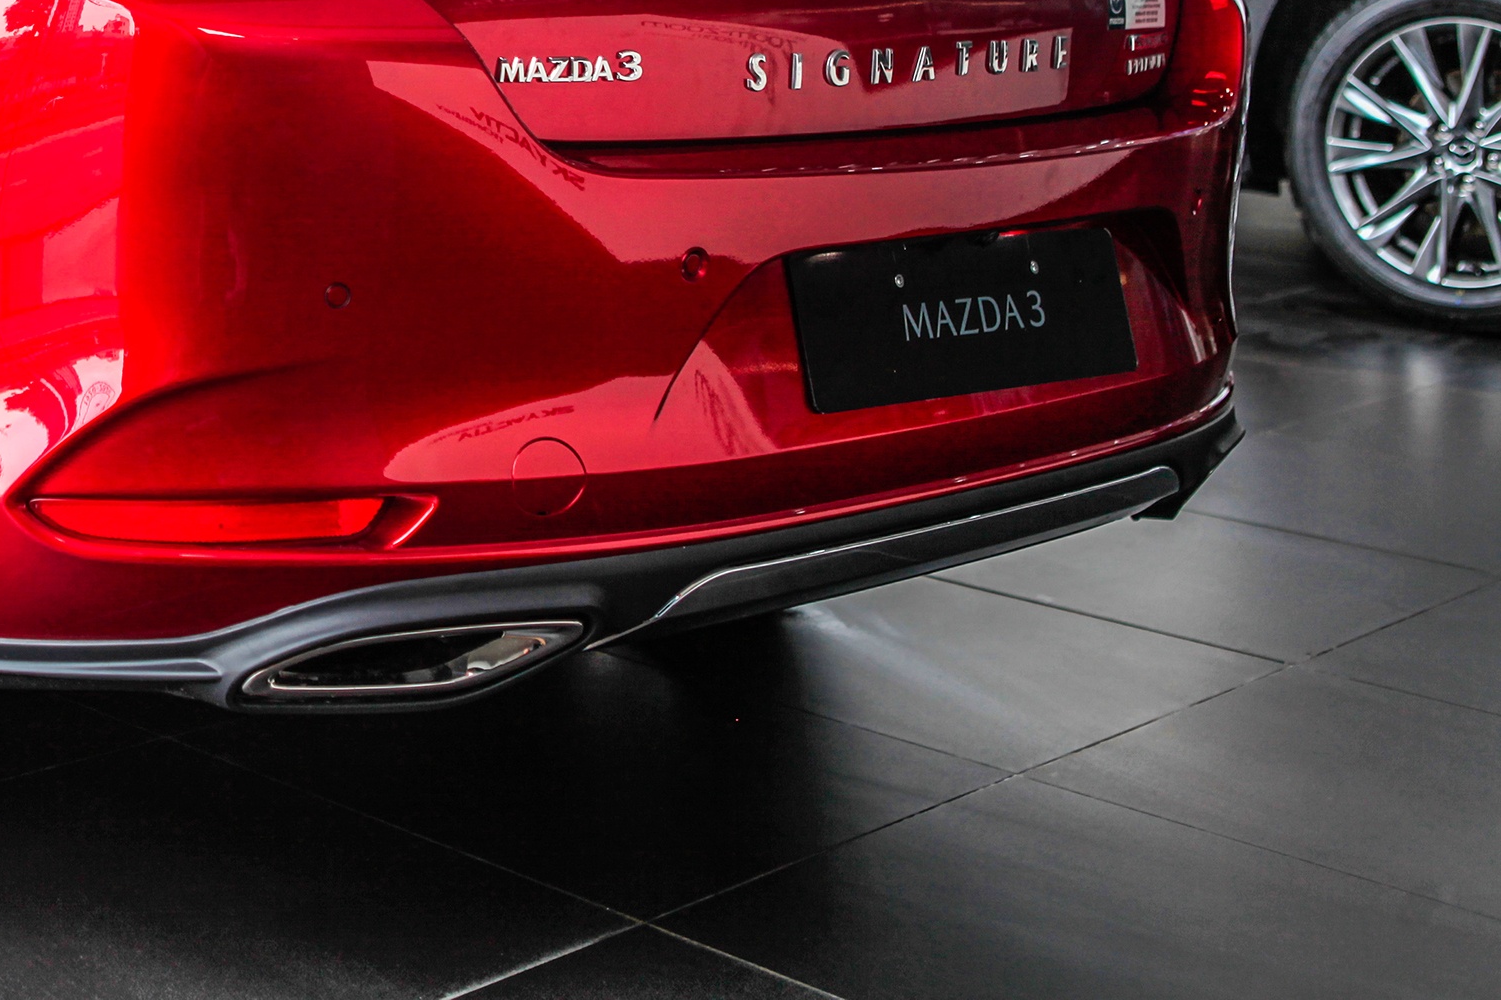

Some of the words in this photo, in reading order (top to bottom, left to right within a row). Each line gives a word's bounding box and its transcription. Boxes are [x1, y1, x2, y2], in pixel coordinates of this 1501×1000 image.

[495, 50, 644, 83] MAZDA3
[744, 35, 1069, 92] SIGNATURE
[902, 290, 1046, 342] MAZDA3
